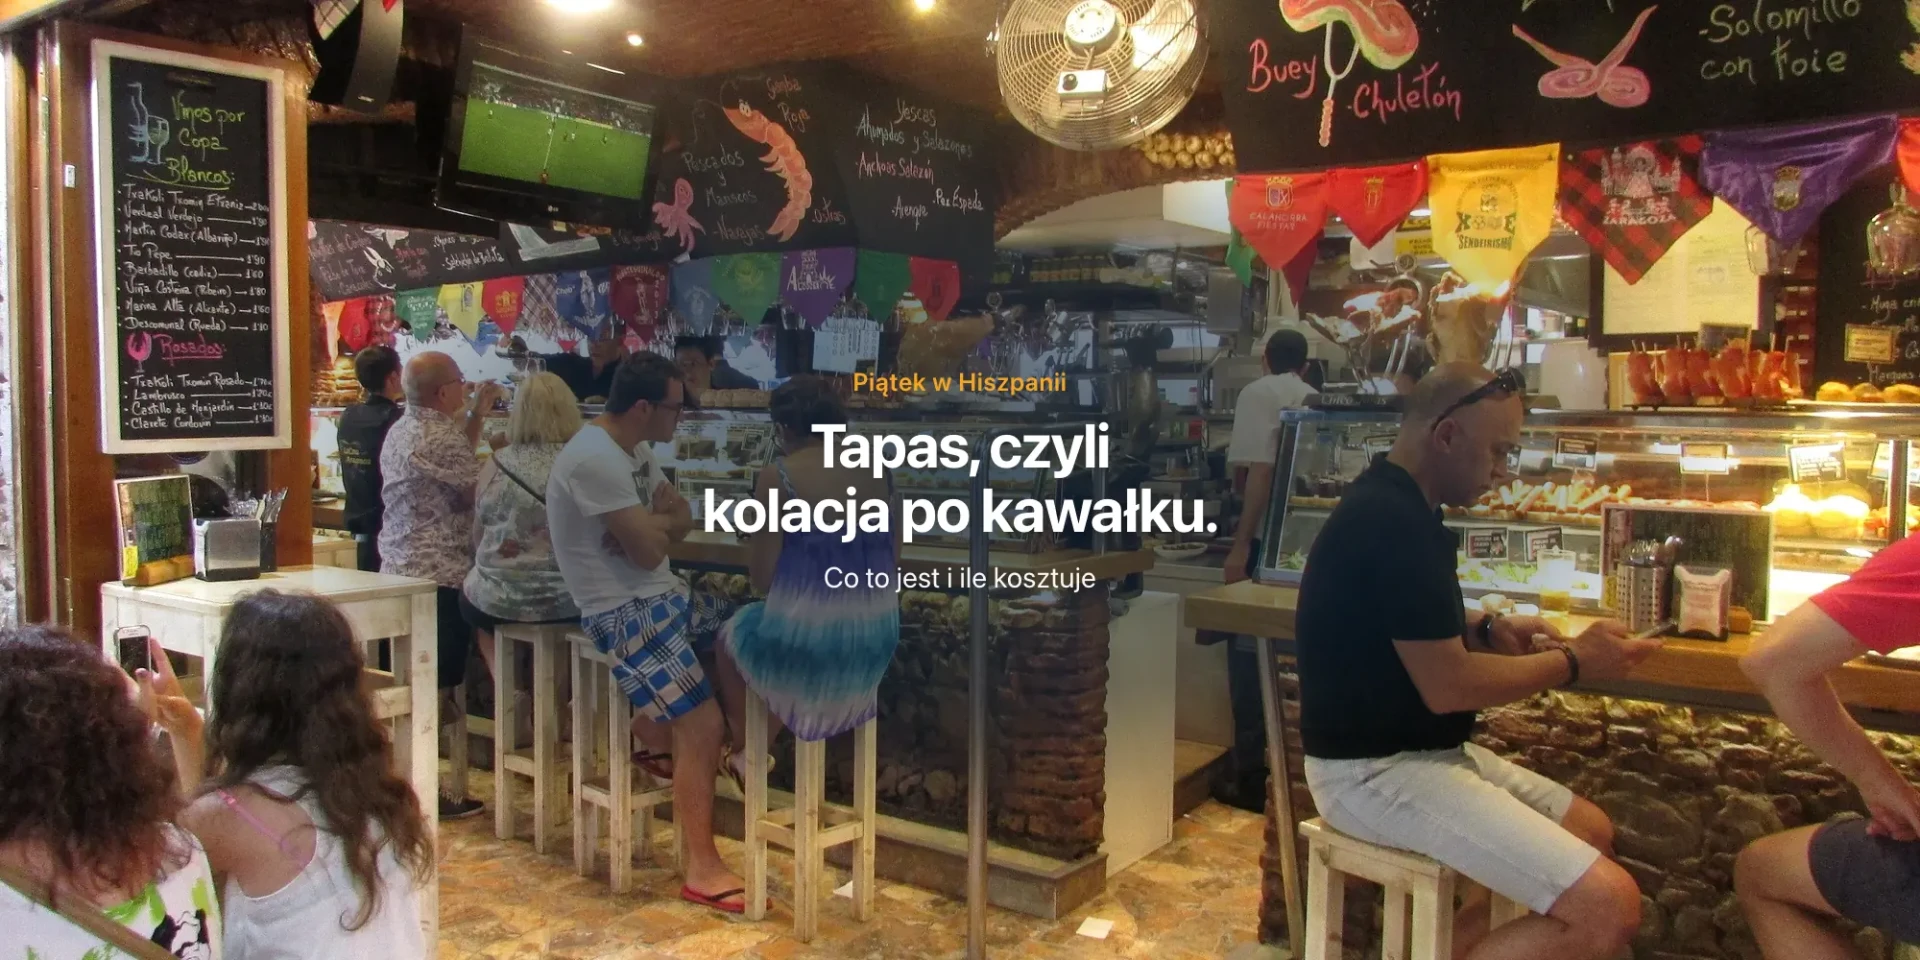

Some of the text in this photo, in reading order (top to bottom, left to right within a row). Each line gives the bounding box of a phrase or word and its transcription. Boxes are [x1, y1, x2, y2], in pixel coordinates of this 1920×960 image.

[1247, 38, 1316, 99] Buey
[1700, 56, 1757, 85] con
[1354, 61, 1462, 125] Chuletón
[216, 109, 245, 135] por
[777, 102, 810, 133] Roja
[856, 102, 973, 160] Ahumados y Salazones
[179, 128, 228, 161] Copa
[681, 143, 745, 173] Pescados
[859, 151, 897, 179] Anchoas
[717, 171, 727, 186] y
[168, 205, 203, 230] Verdejo
[1250, 212, 1308, 222] CALAHORRA
[1257, 221, 1296, 231] FIESTAS
[1603, 213, 1677, 226] ZARAGOZA
[160, 224, 190, 241] Codax
[142, 242, 173, 265] Pepe
[123, 261, 179, 277] Barbadillo
[125, 275, 150, 296] Viña
[125, 297, 157, 315] Marina
[164, 298, 185, 312] Alta
[124, 317, 184, 331] Descomunal
[189, 317, 227, 332] (Rueda)
[177, 373, 211, 388] Txomin
[208, 372, 244, 391] Rosado
[134, 389, 185, 400] Lambrusco
[132, 401, 172, 416] Castillo
[176, 402, 187, 415] de
[130, 416, 168, 430] Clarete
